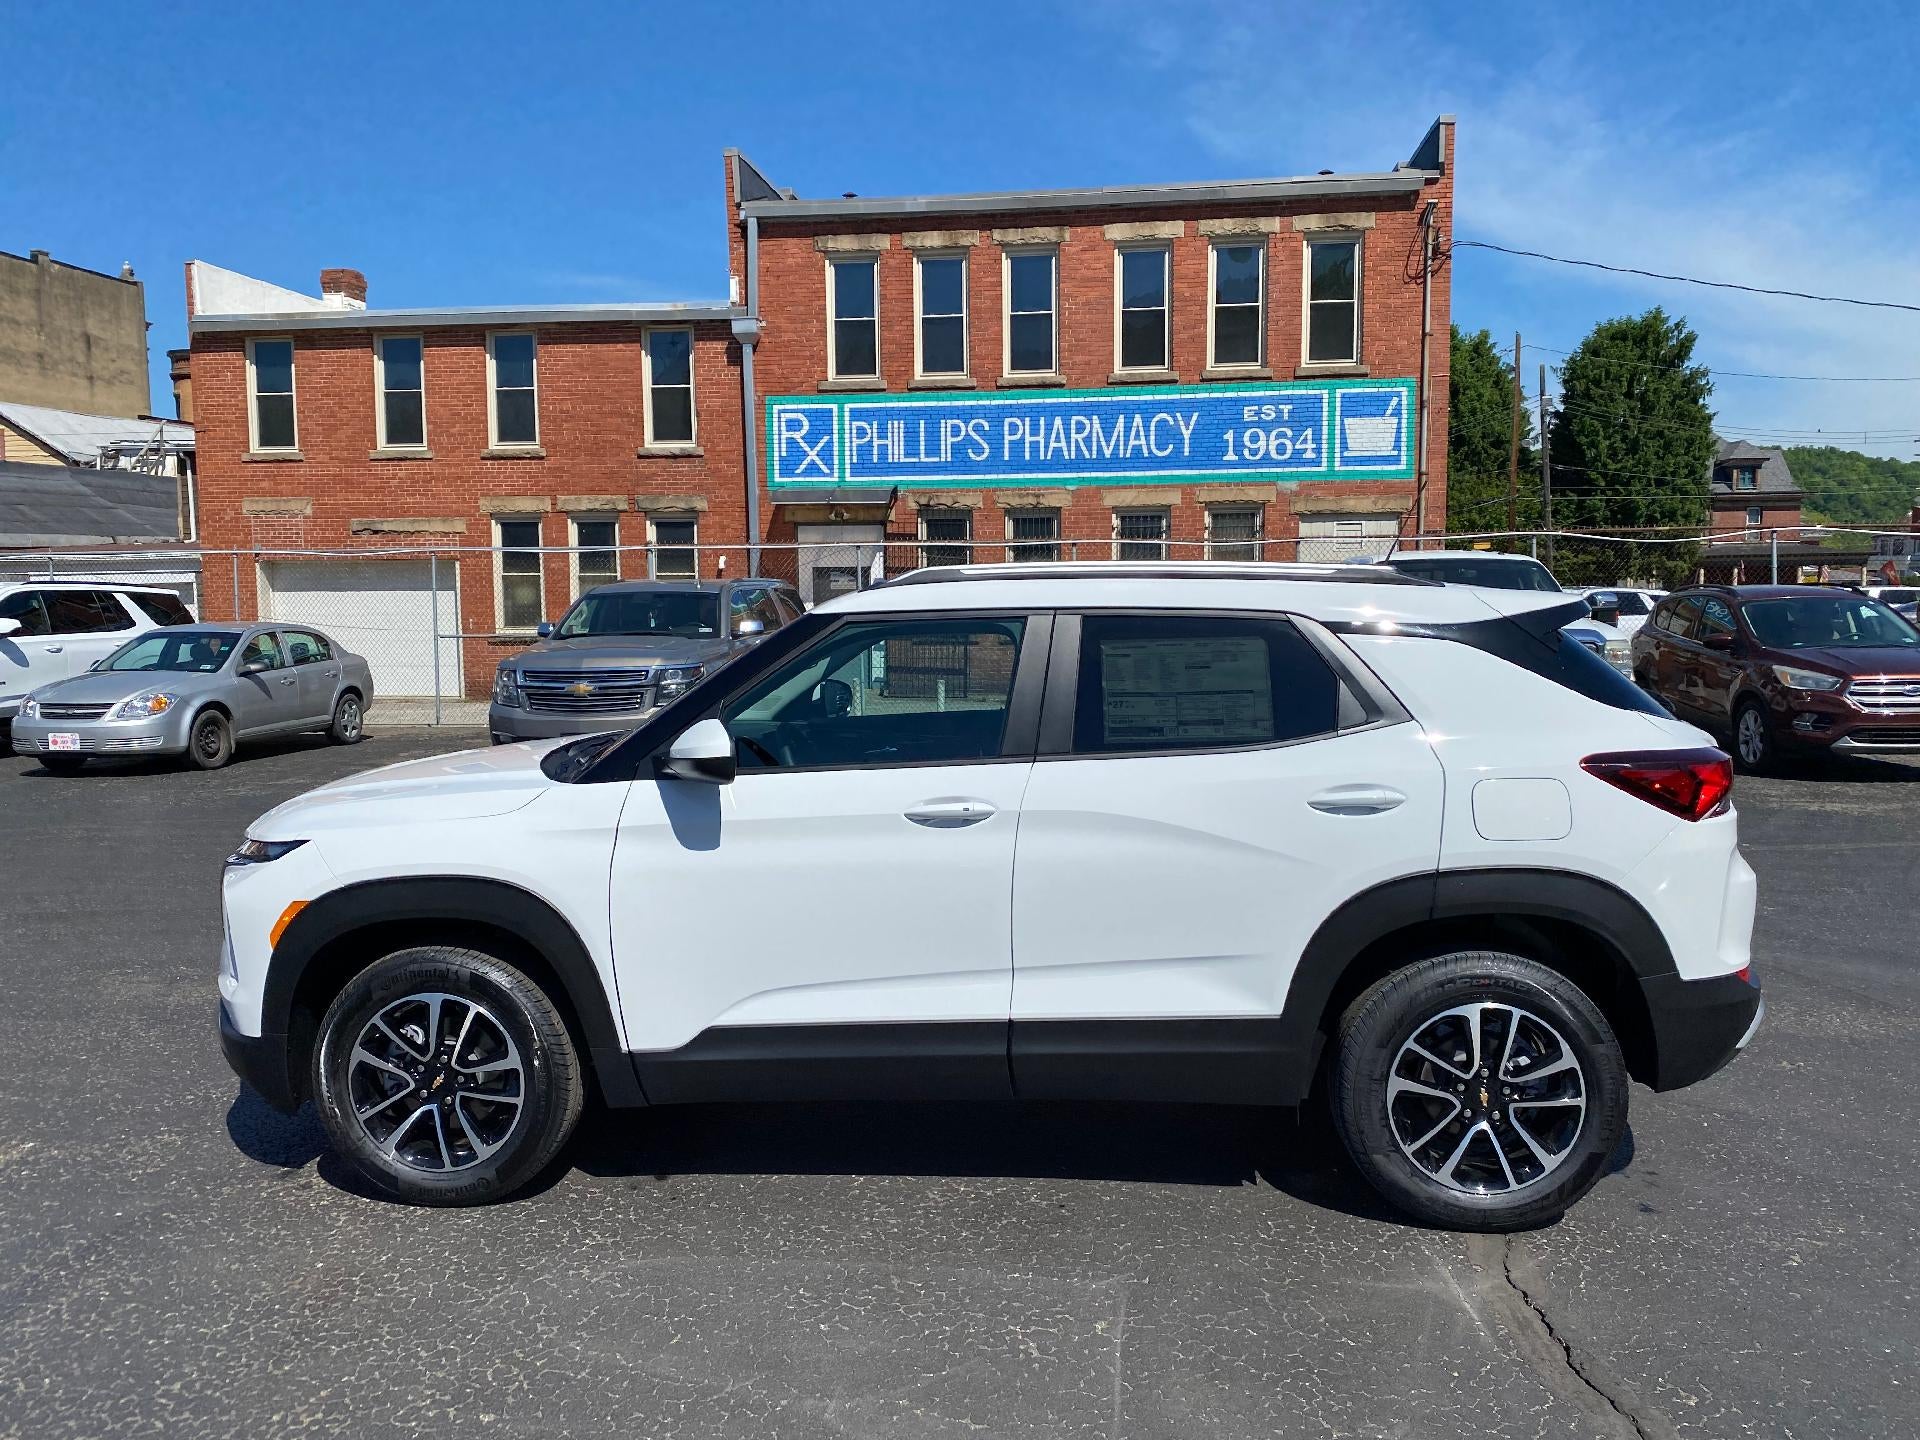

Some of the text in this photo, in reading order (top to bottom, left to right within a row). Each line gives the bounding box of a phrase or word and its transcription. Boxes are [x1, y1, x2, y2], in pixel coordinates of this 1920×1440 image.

[1242, 404, 1293, 422] EST
[851, 411, 1199, 464] PHILLIPS PHARMACY
[1222, 427, 1317, 461] 1964
